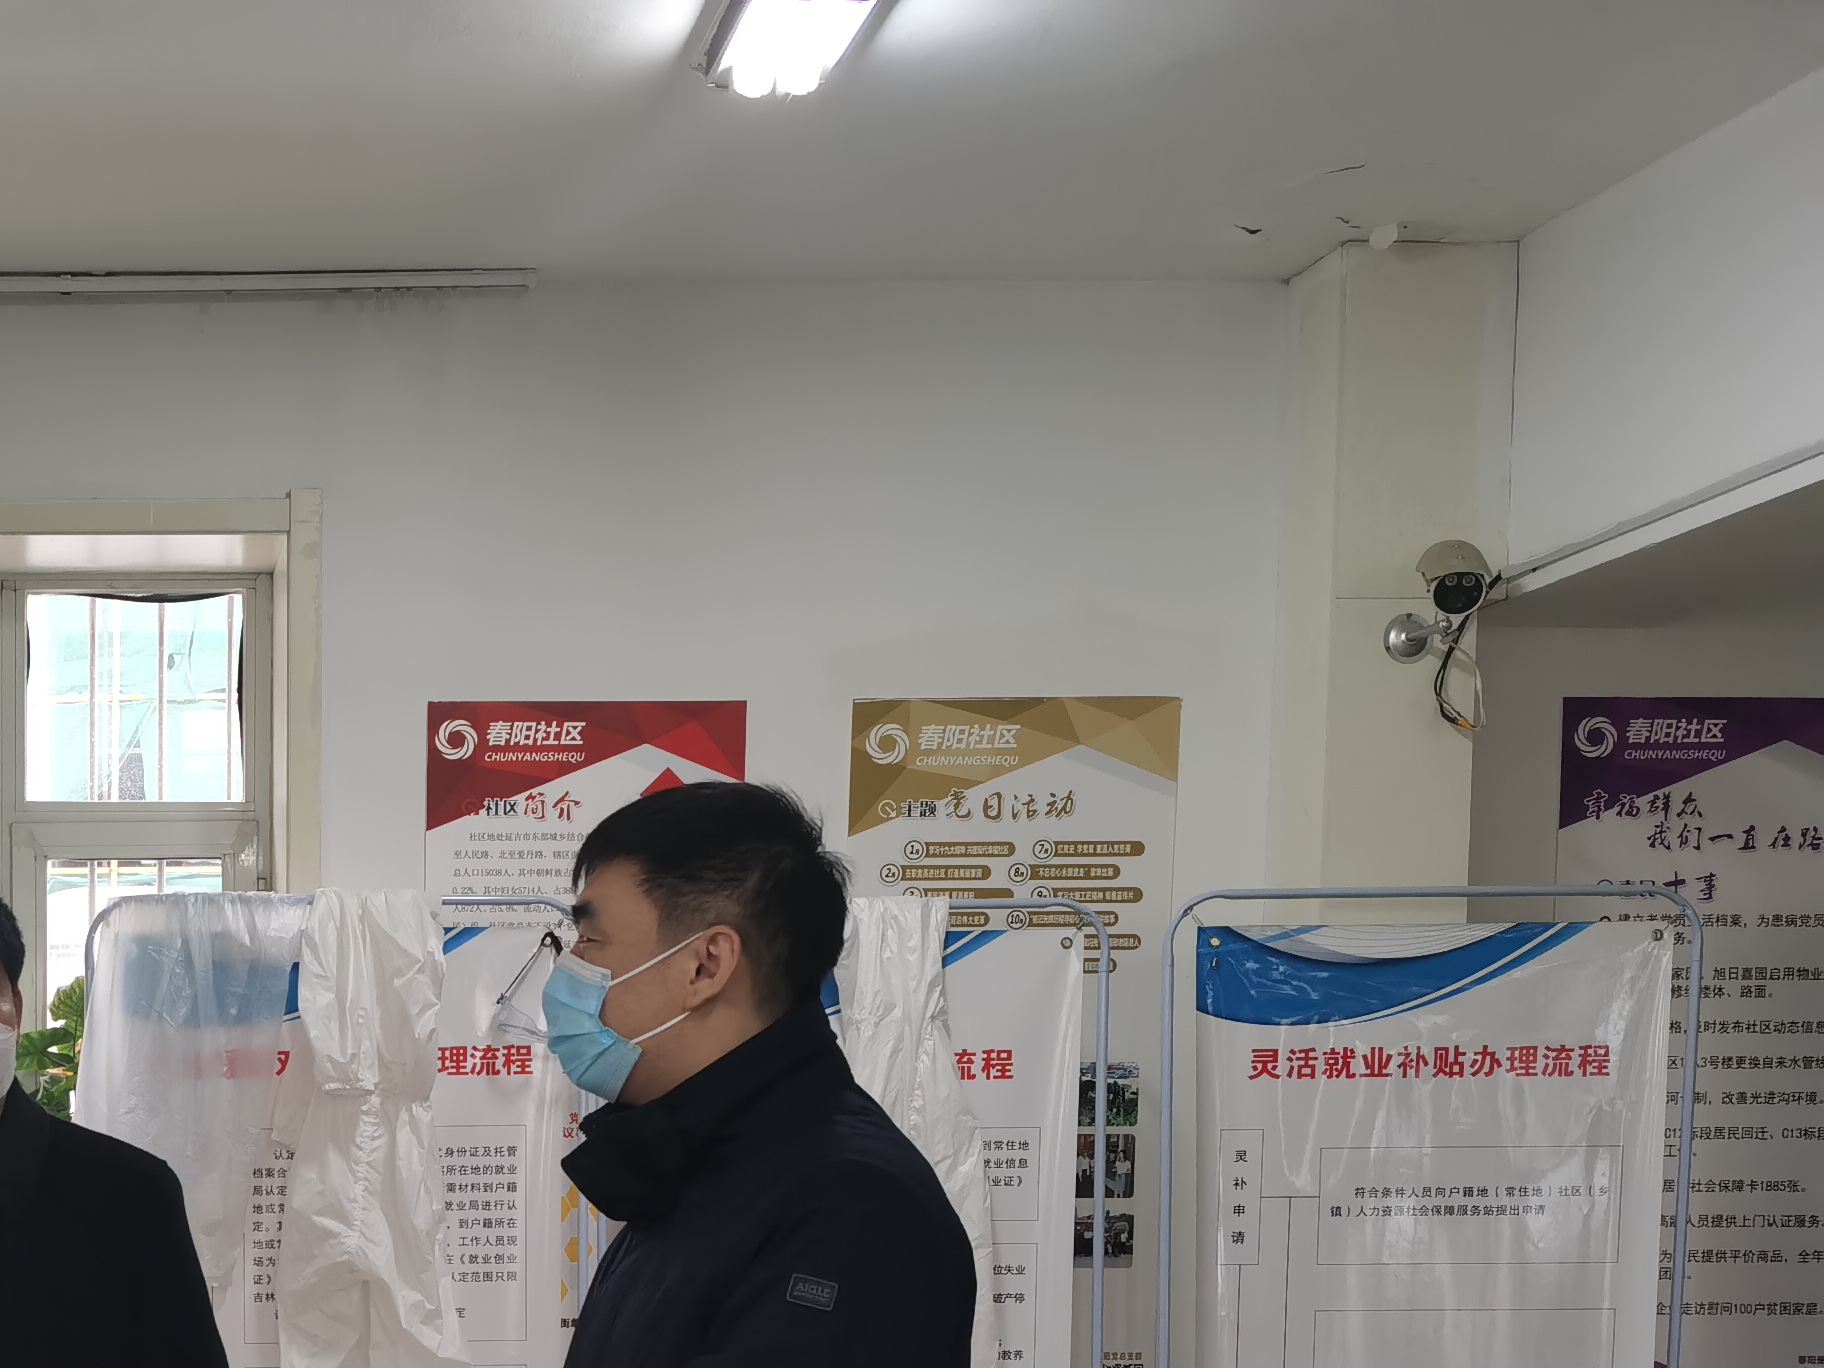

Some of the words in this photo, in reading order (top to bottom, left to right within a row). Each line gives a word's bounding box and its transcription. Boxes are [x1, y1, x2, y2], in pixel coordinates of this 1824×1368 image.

[486, 720, 586, 747] 春阳社区
[918, 724, 1021, 750] 春阳社区
[1626, 718, 1727, 743] 春阳社区
[484, 751, 586, 763] CHUNYANGSHEQU
[916, 755, 1019, 766] CHUNYANGSHEQU
[1624, 749, 1726, 760] CHUNYANGSHEQU
[484, 790, 582, 823] 社区简介
[901, 788, 1076, 822] 主题党日活动
[1247, 1044, 1611, 1081] 灵活就业补贴办理流程
[438, 1146, 518, 1159] 身份证及托管
[253, 1168, 290, 1180] 档案合
[441, 1164, 518, 1177] 所在地的就业
[987, 1175, 1023, 1187] 业证》
[1662, 1179, 1806, 1193] 居社会保障卡1885张。
[252, 1185, 287, 1197] 局认定
[443, 1182, 518, 1194] 需材料到户籍
[1231, 1148, 1248, 1246] 灵补申请
[1659, 1250, 1824, 1263] 为民提供平价商品，全年
[992, 1264, 1026, 1276] 位失业
[1657, 1302, 1824, 1316] 企走访慰问100户贫困家庭。
